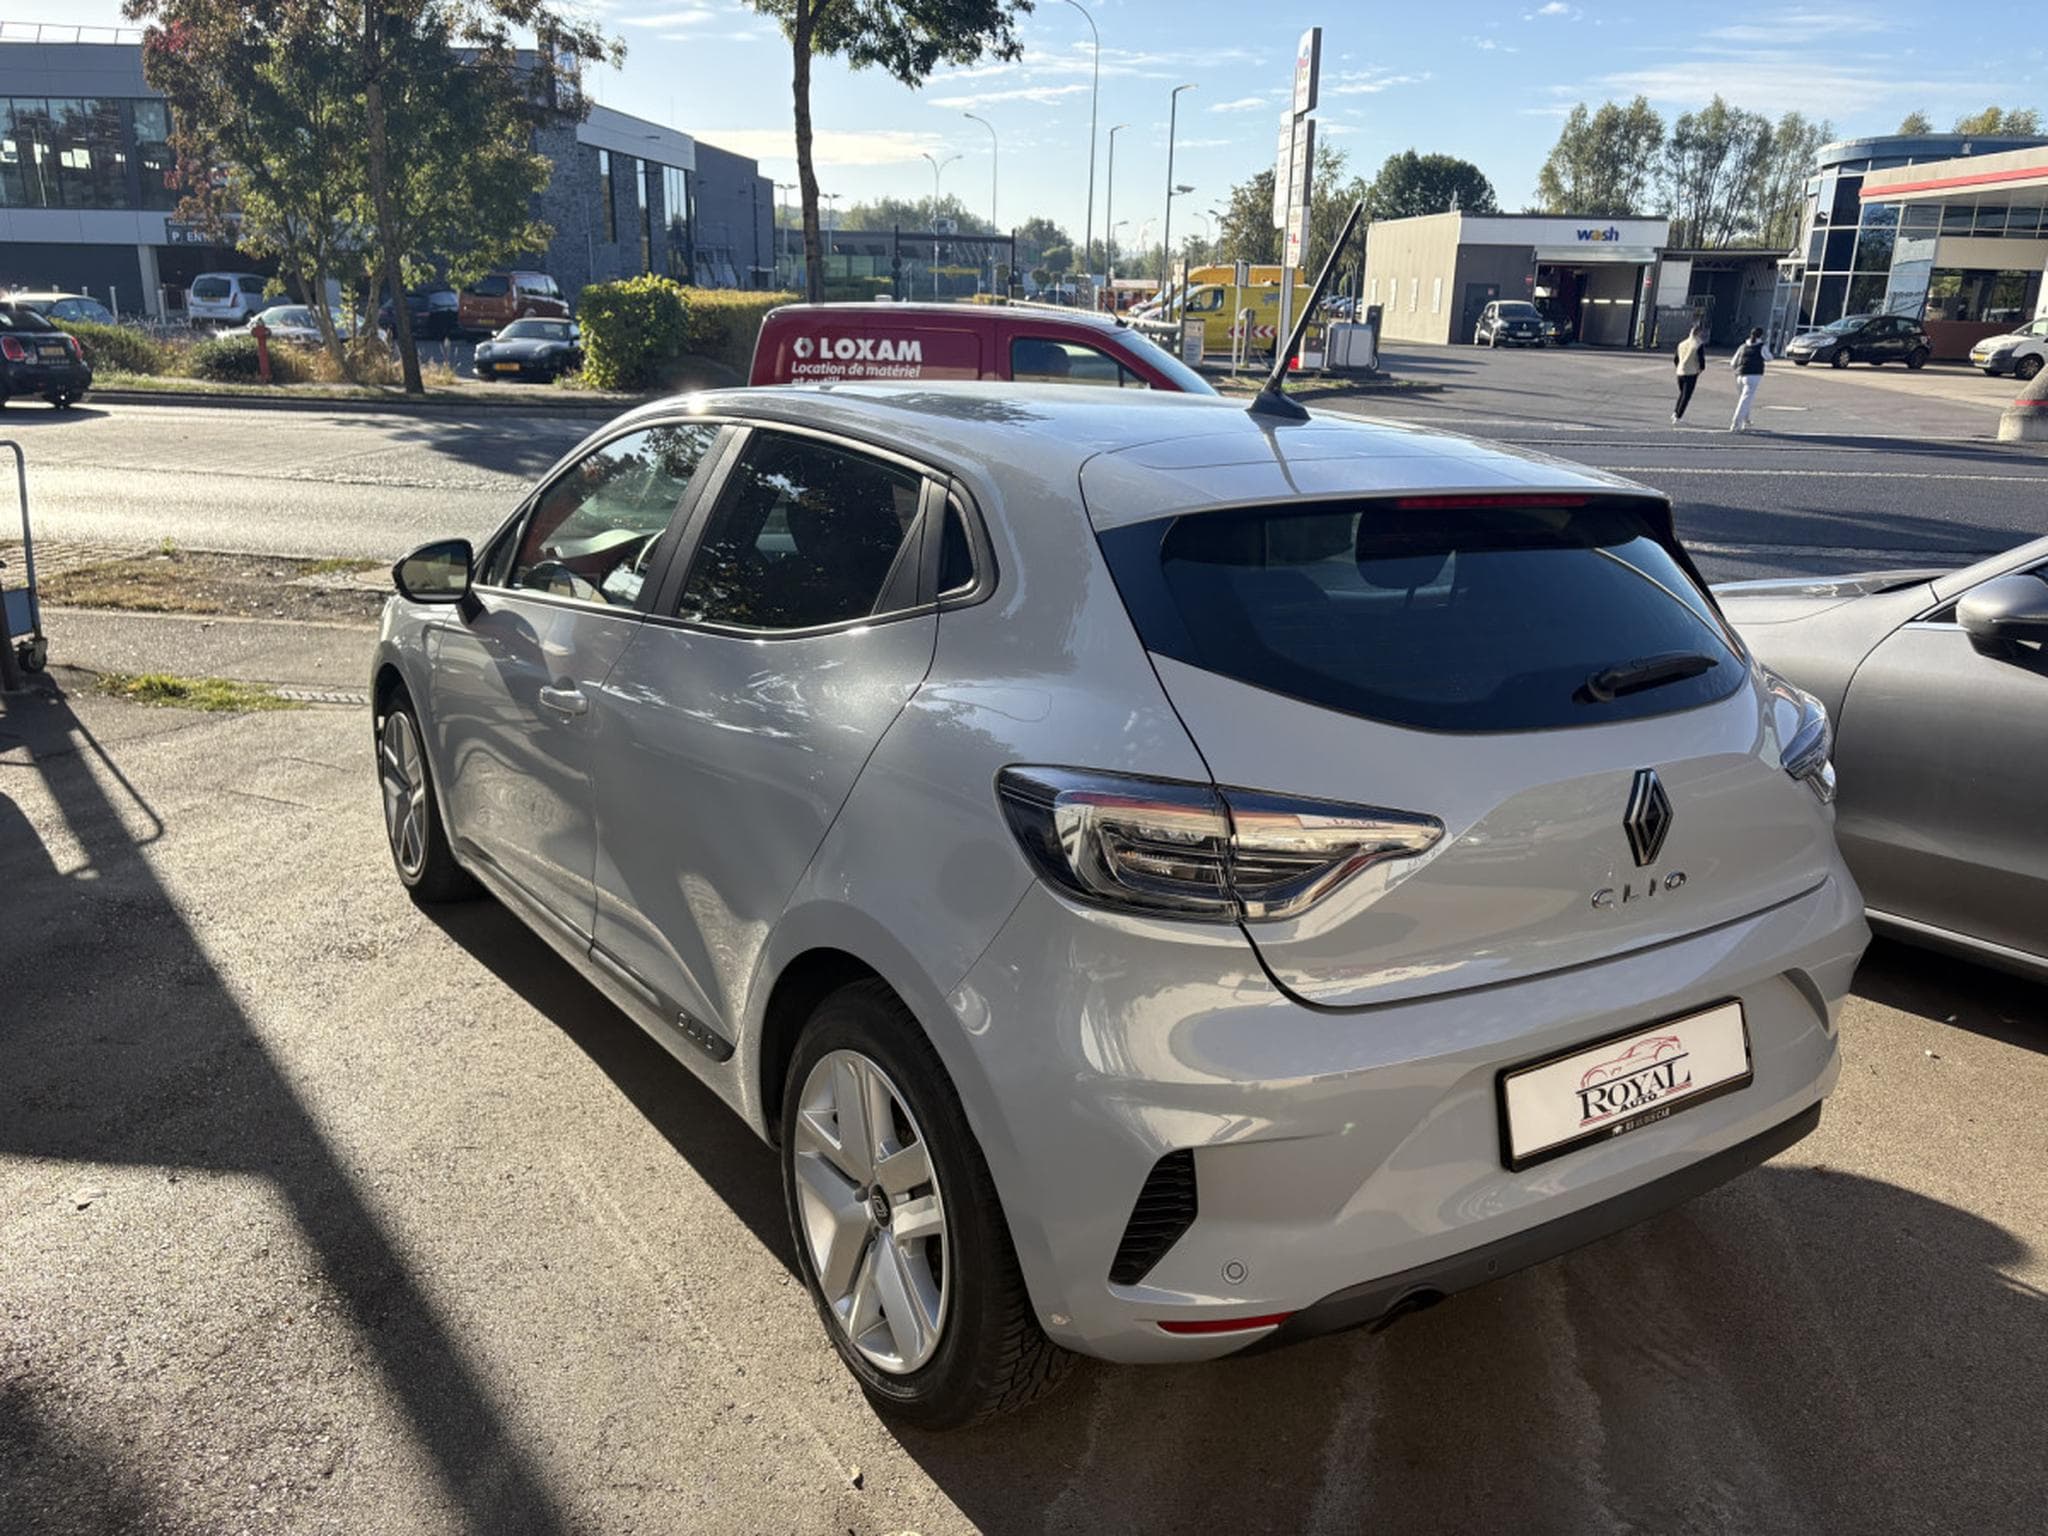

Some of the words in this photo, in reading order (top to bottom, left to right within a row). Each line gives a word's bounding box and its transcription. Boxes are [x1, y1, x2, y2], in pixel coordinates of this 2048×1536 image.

[1577, 226, 1619, 241] wash
[820, 337, 922, 362] LOXAM
[792, 361, 846, 375] Location
[848, 363, 864, 376] de
[866, 364, 921, 379] matériel
[1591, 871, 1687, 909] CLIO
[1576, 1062, 1691, 1120] ROYAL
[1620, 1091, 1657, 1112] AUTO
